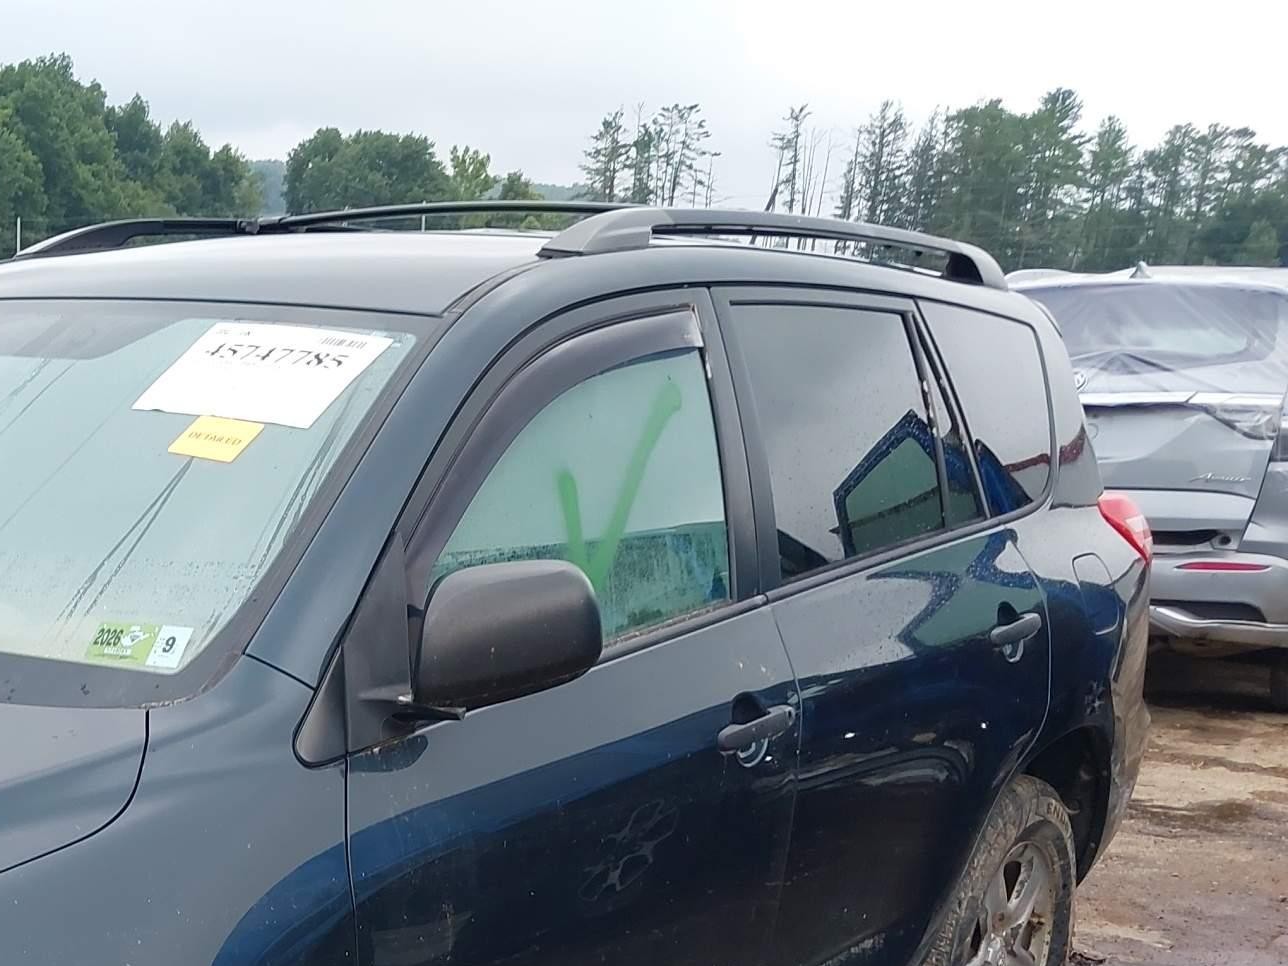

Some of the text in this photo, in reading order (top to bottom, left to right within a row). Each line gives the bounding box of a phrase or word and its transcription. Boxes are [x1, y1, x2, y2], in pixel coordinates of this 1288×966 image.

[206, 343, 349, 368] 45747785
[93, 627, 124, 647] 2026
[162, 636, 177, 653] 9
